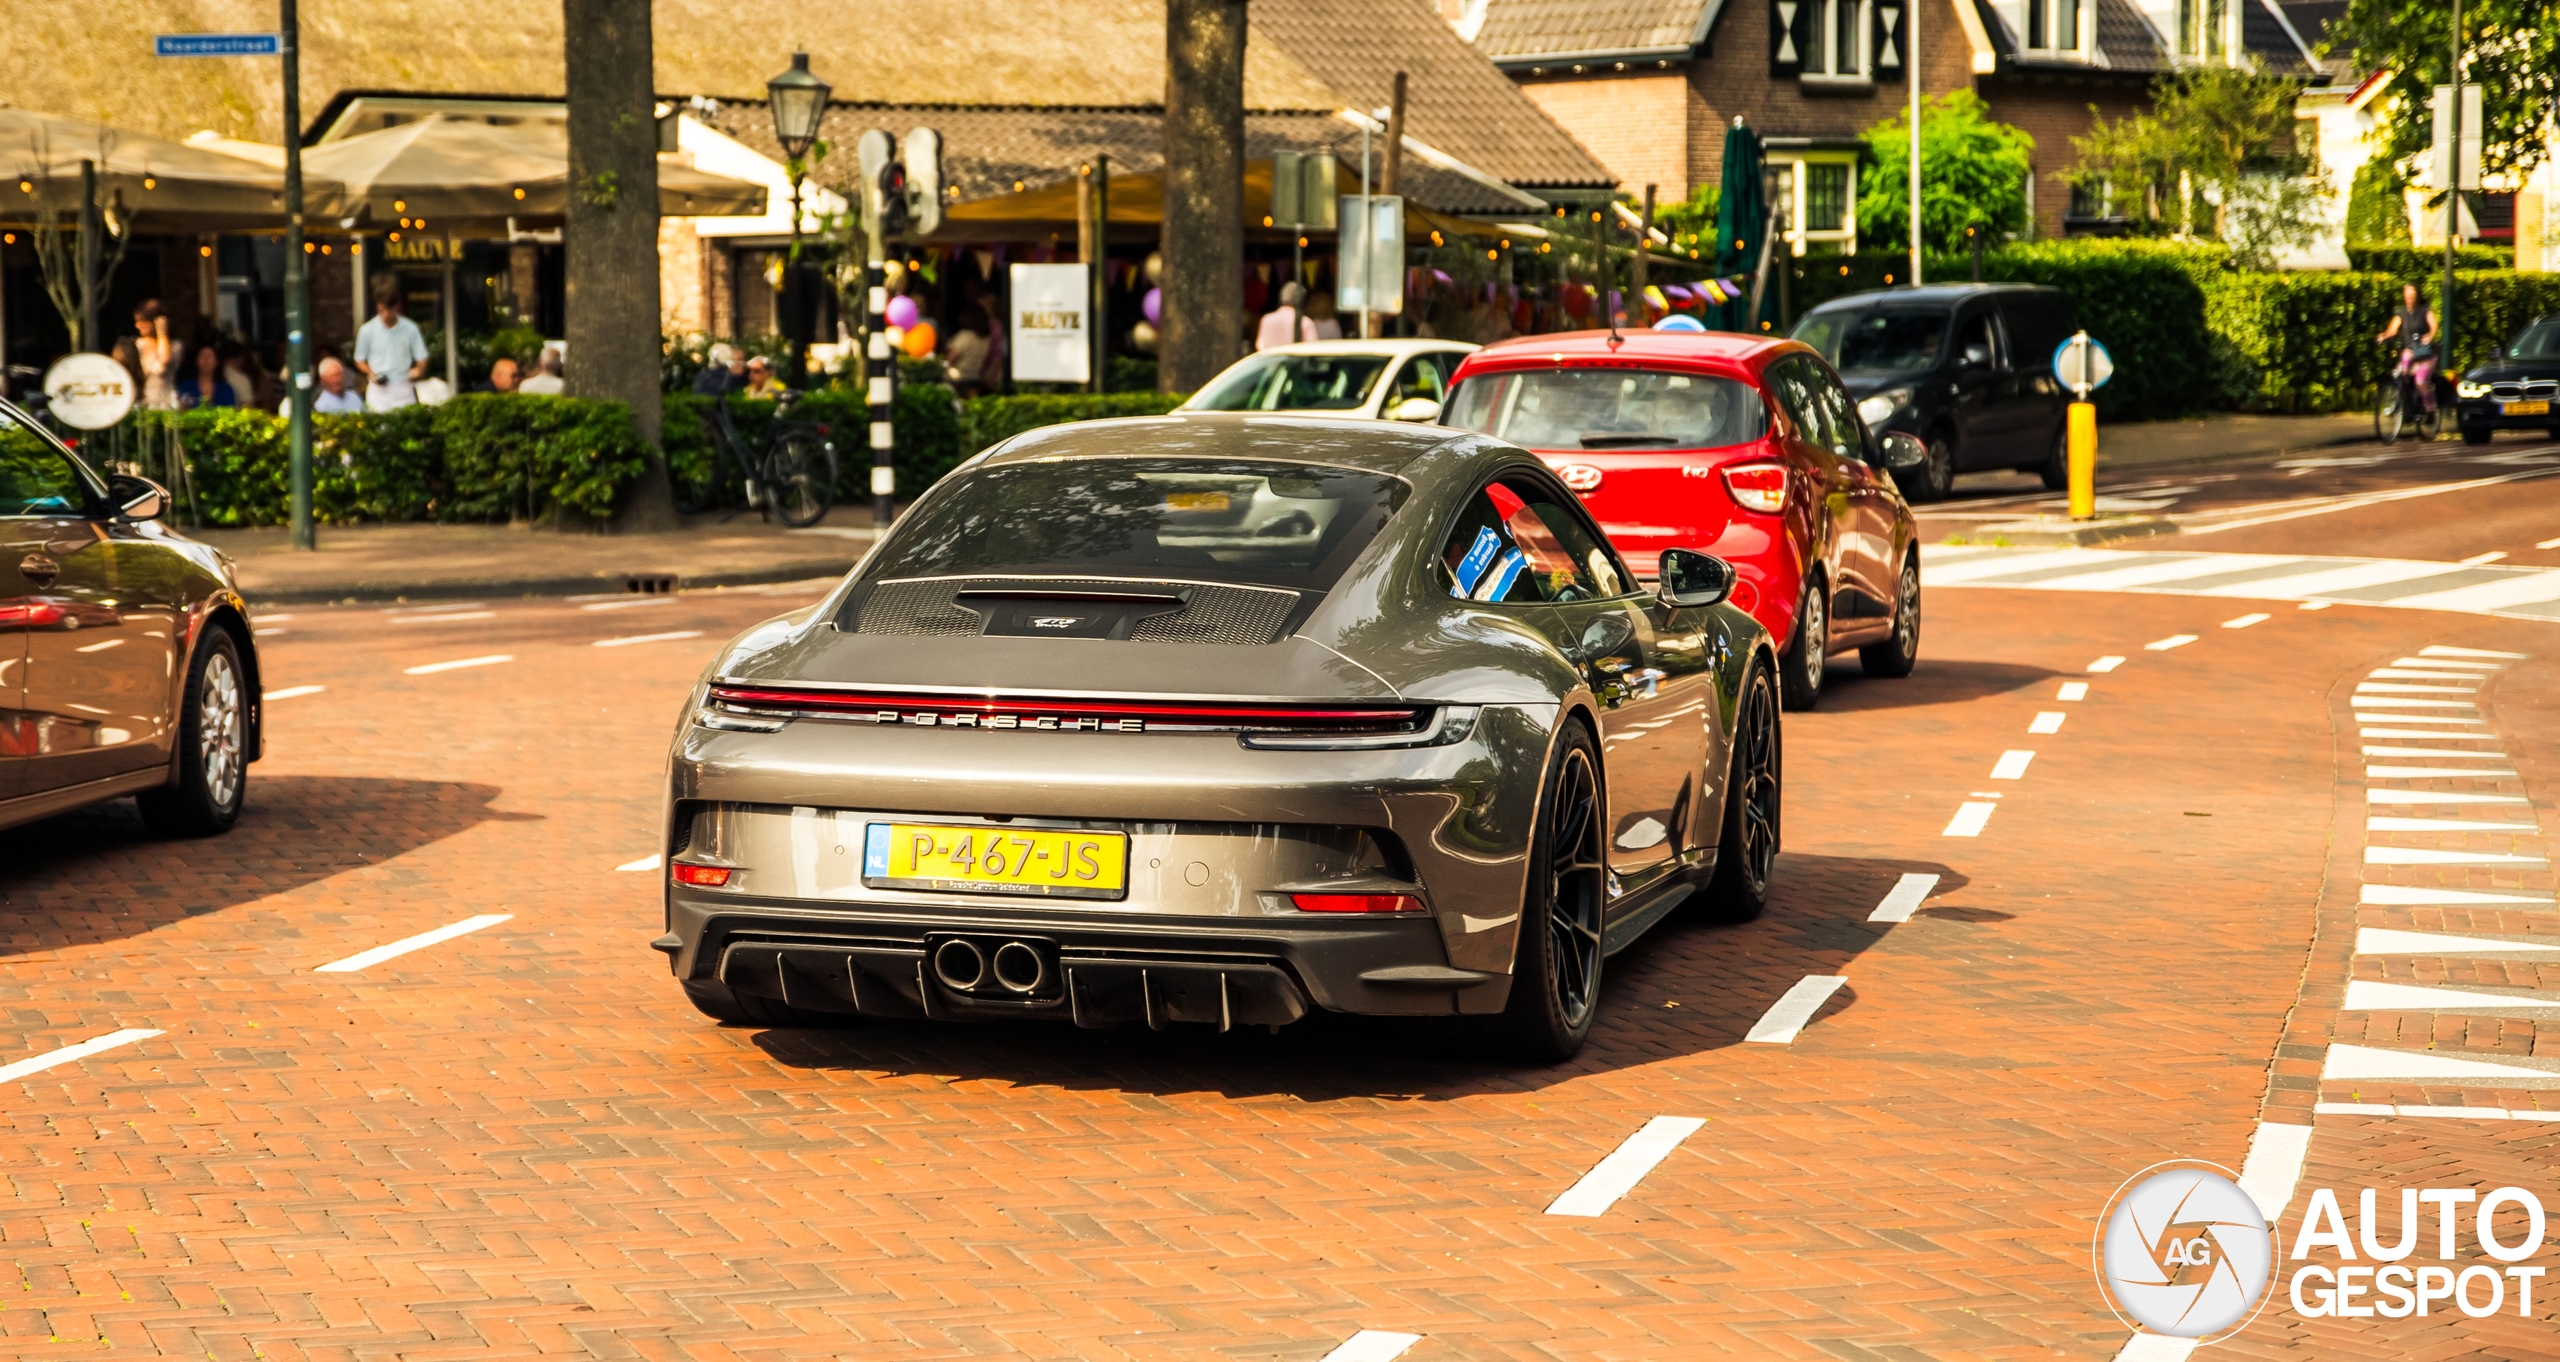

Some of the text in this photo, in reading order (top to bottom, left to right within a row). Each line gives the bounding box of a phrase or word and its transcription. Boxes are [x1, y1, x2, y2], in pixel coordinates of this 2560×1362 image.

[162, 41, 270, 52] Noorderstraat
[877, 711, 1143, 732] PORSCHE
[868, 855, 885, 869] NL
[910, 833, 1100, 880] P-467-JS
